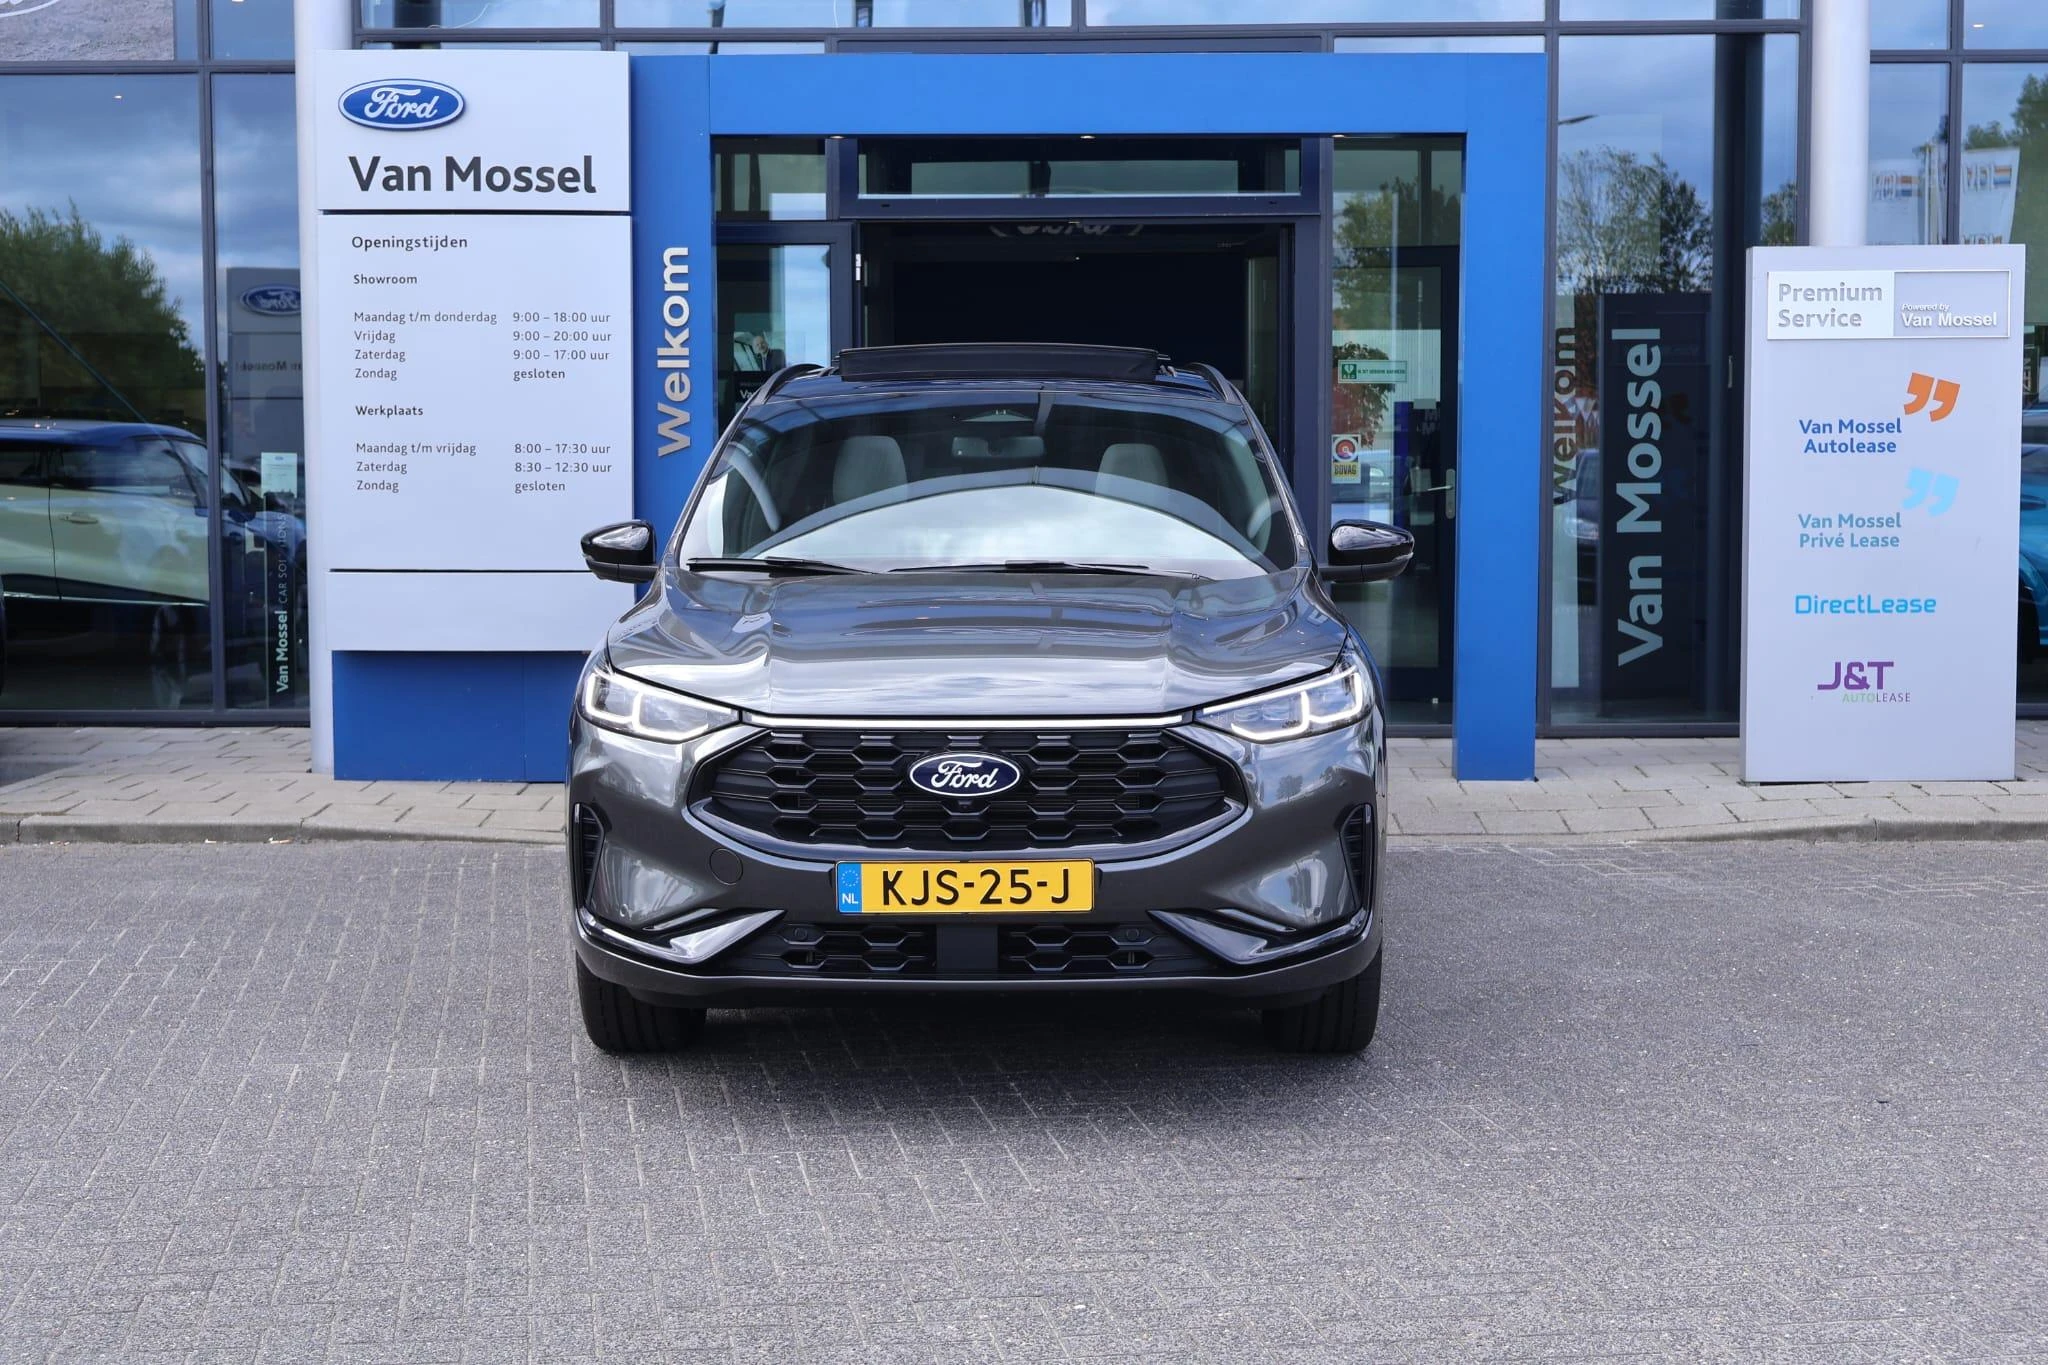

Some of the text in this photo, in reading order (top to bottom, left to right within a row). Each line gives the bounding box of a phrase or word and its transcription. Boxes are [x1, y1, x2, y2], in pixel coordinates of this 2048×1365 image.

[363, 87, 439, 119] Ford
[348, 155, 596, 193] Van Mossel
[352, 236, 468, 251] Openingstijden
[354, 274, 417, 284] Showroom
[1778, 282, 1883, 302] Premium
[1901, 303, 1950, 312] Powered by
[354, 312, 497, 325] Maandag t/m donderdag
[513, 312, 540, 322] 9:00
[554, 312, 586, 322] 18:00
[591, 314, 611, 322] uur
[1778, 308, 1862, 327] Service
[1902, 312, 1997, 327] Van Mossel
[354, 331, 396, 344] Vrijdag
[513, 331, 540, 341] 9:00
[553, 331, 588, 341] 20:00
[592, 333, 611, 341] uur
[354, 349, 406, 362] Zaterdag
[513, 350, 540, 360] 9:00
[554, 350, 586, 360] 17:00
[590, 352, 609, 360] uur
[657, 247, 691, 457] Welkom
[355, 368, 397, 380] Zondag
[513, 369, 565, 381] gesloten
[355, 405, 423, 418] Werkplaats
[1799, 418, 1902, 434] Van Mossel
[356, 443, 476, 456] Maandag t/m vrijdag
[514, 444, 541, 453] 8:00
[555, 443, 587, 454] 17:30
[591, 445, 611, 454] uur
[1804, 438, 1897, 453] Autolease
[356, 461, 407, 474] Zaterdag
[515, 462, 541, 472] 8:30
[555, 462, 588, 472] 12:30
[592, 464, 611, 472] uur
[357, 480, 399, 493] Zondag
[515, 481, 565, 494] gesloten
[1612, 328, 1663, 667] Van Mossel
[1798, 512, 1902, 528] Van Mossel
[1800, 532, 1900, 547] Privé Lease
[1795, 594, 1936, 614] DirectLease
[275, 610, 288, 661] Mossel
[276, 665, 288, 692] Van
[1818, 662, 1894, 690] J&T
[1842, 692, 1911, 703] AUTOLEASE
[931, 761, 999, 788] Ford
[842, 869, 1069, 906] NL KJS-25-J
